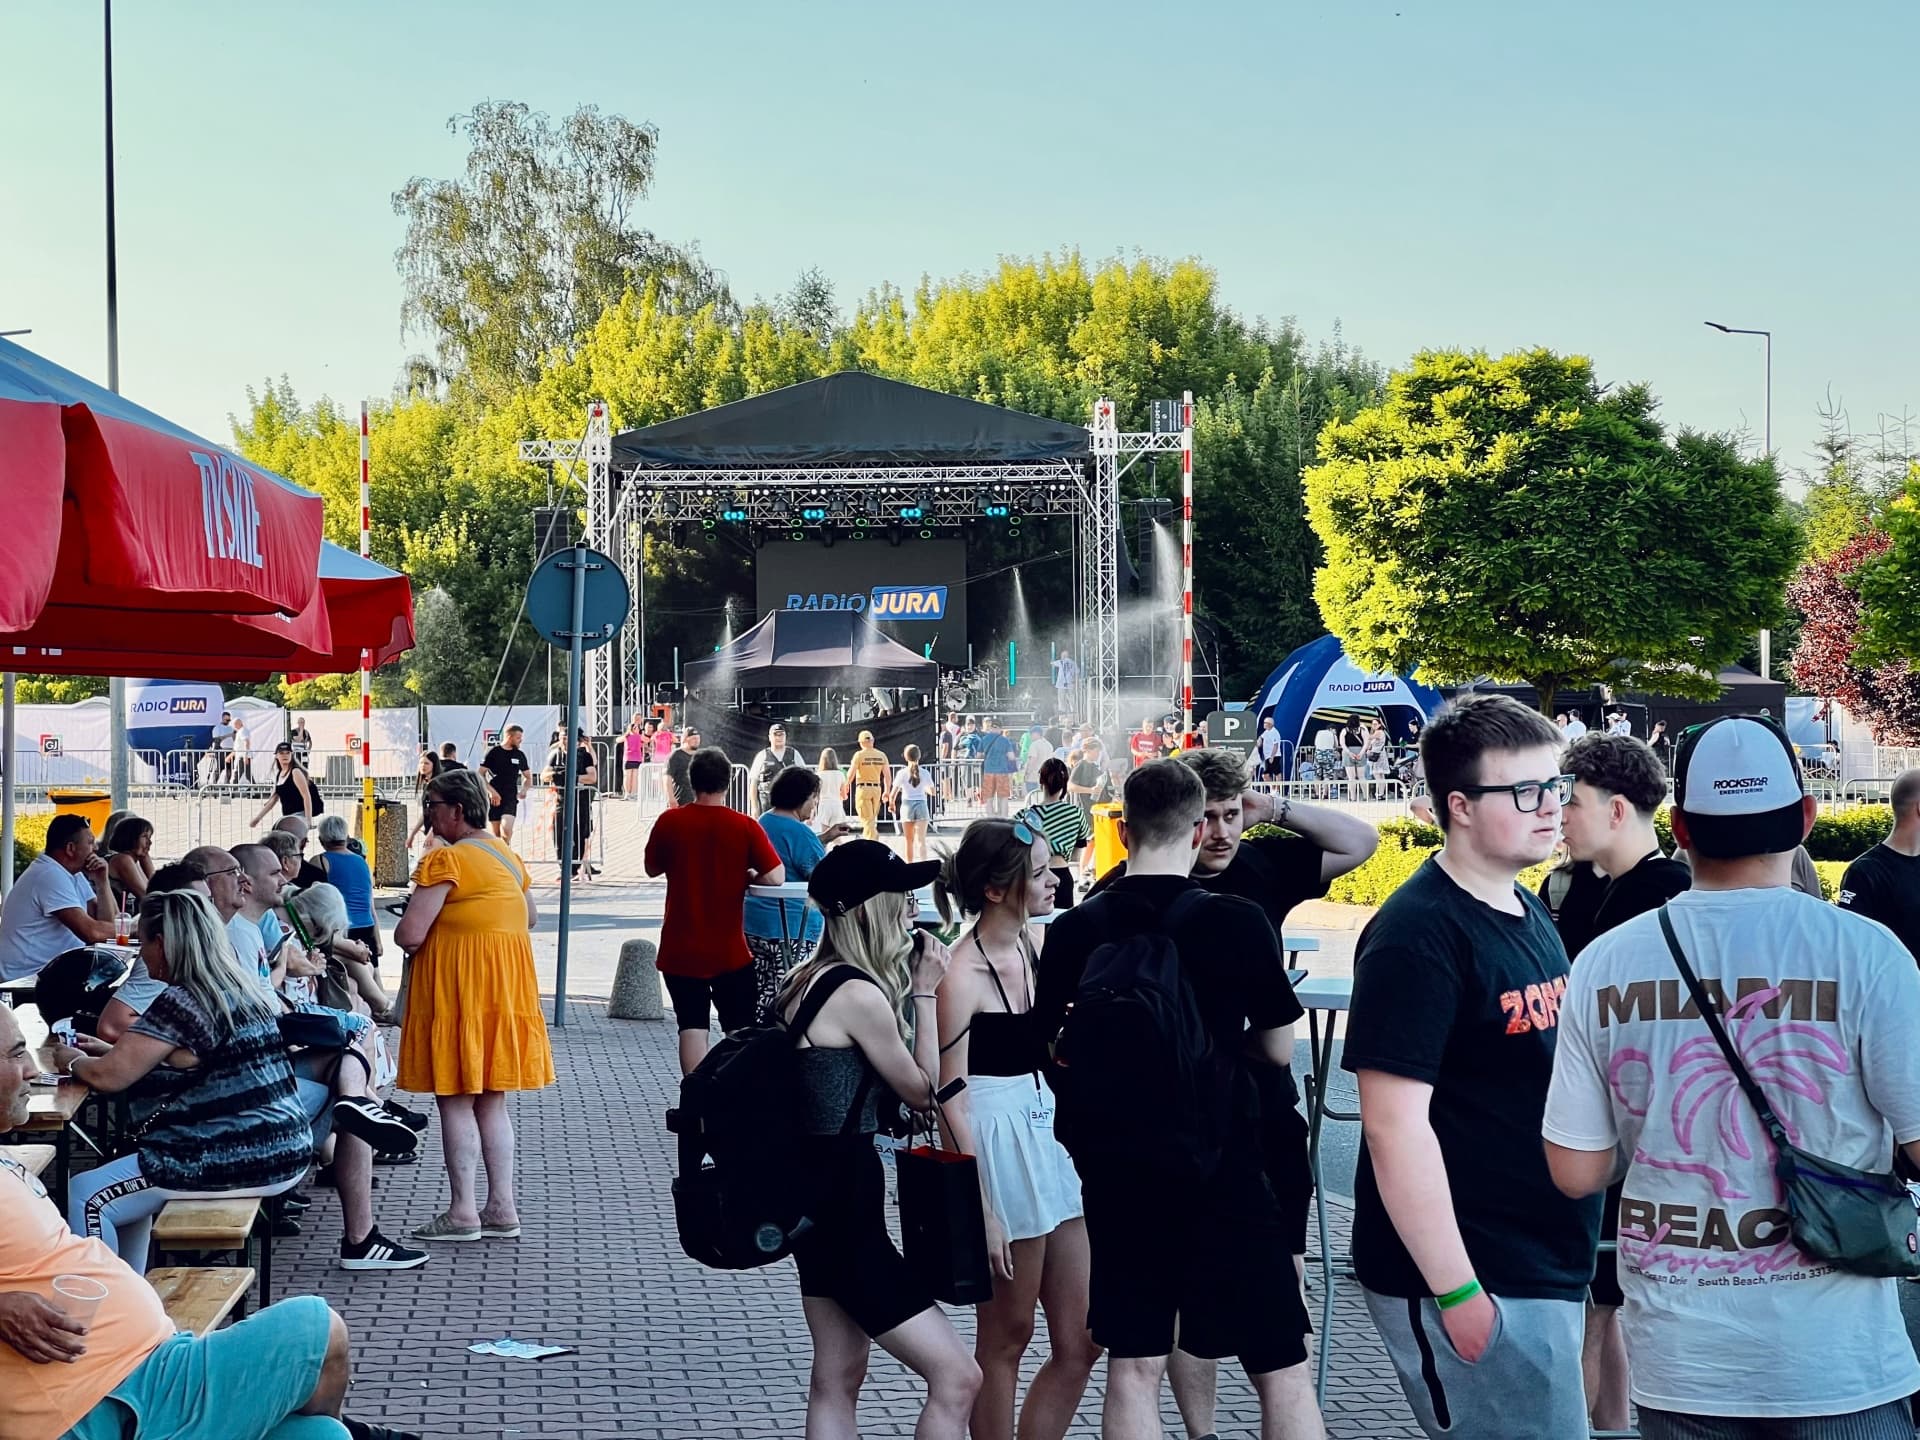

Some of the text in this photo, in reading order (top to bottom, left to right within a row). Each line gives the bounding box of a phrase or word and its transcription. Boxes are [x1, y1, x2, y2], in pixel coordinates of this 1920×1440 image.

[786, 592, 941, 614] RADIO JURA
[1328, 681, 1394, 692] RADIO JURA
[130, 699, 206, 713] RADIO JURA
[1224, 718, 1240, 737] P
[1713, 777, 1769, 789] ROCKSTAR
[1597, 978, 1837, 1028] MIAMI
[1621, 1198, 1793, 1252] BEAC
[1697, 1277, 1730, 1287] South
[1732, 1275, 1768, 1286] Beach,
[1770, 1271, 1807, 1283] Florida
